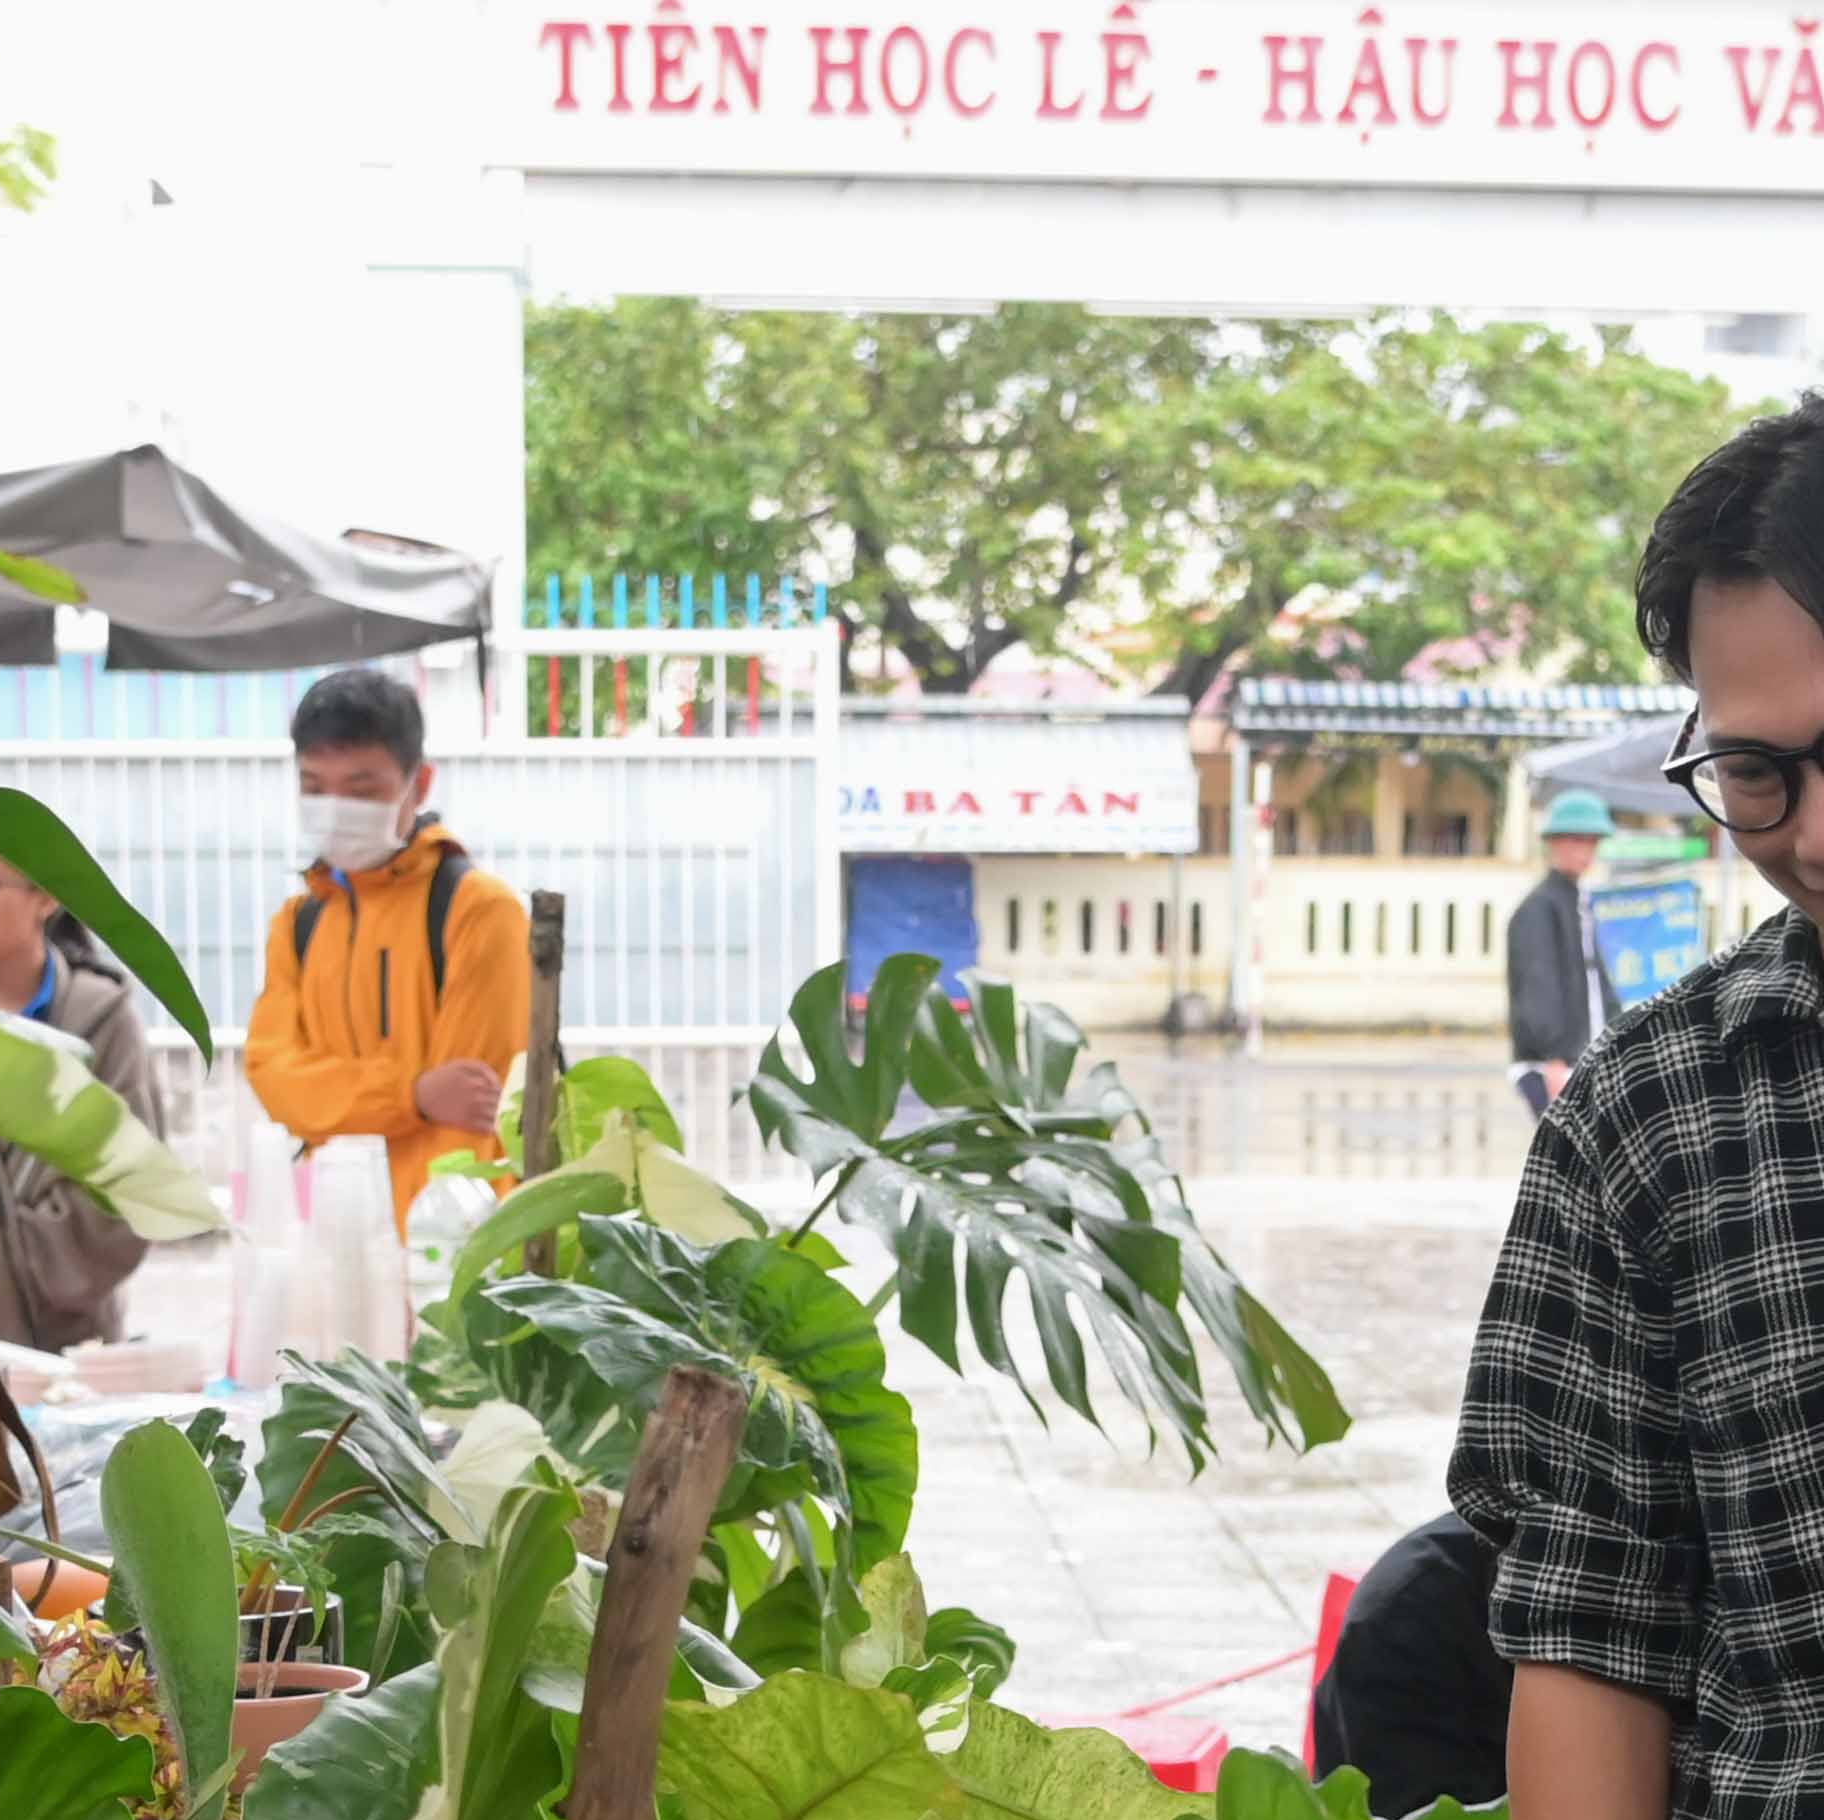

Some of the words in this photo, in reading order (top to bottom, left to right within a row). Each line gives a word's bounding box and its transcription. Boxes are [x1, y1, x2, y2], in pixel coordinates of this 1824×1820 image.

[540, 0, 769, 113] TIÊN
[807, 24, 997, 140] HỌC
[1262, 7, 1459, 143] HẬU
[1496, 40, 1680, 152] HỌC
[903, 791, 983, 814] BA
